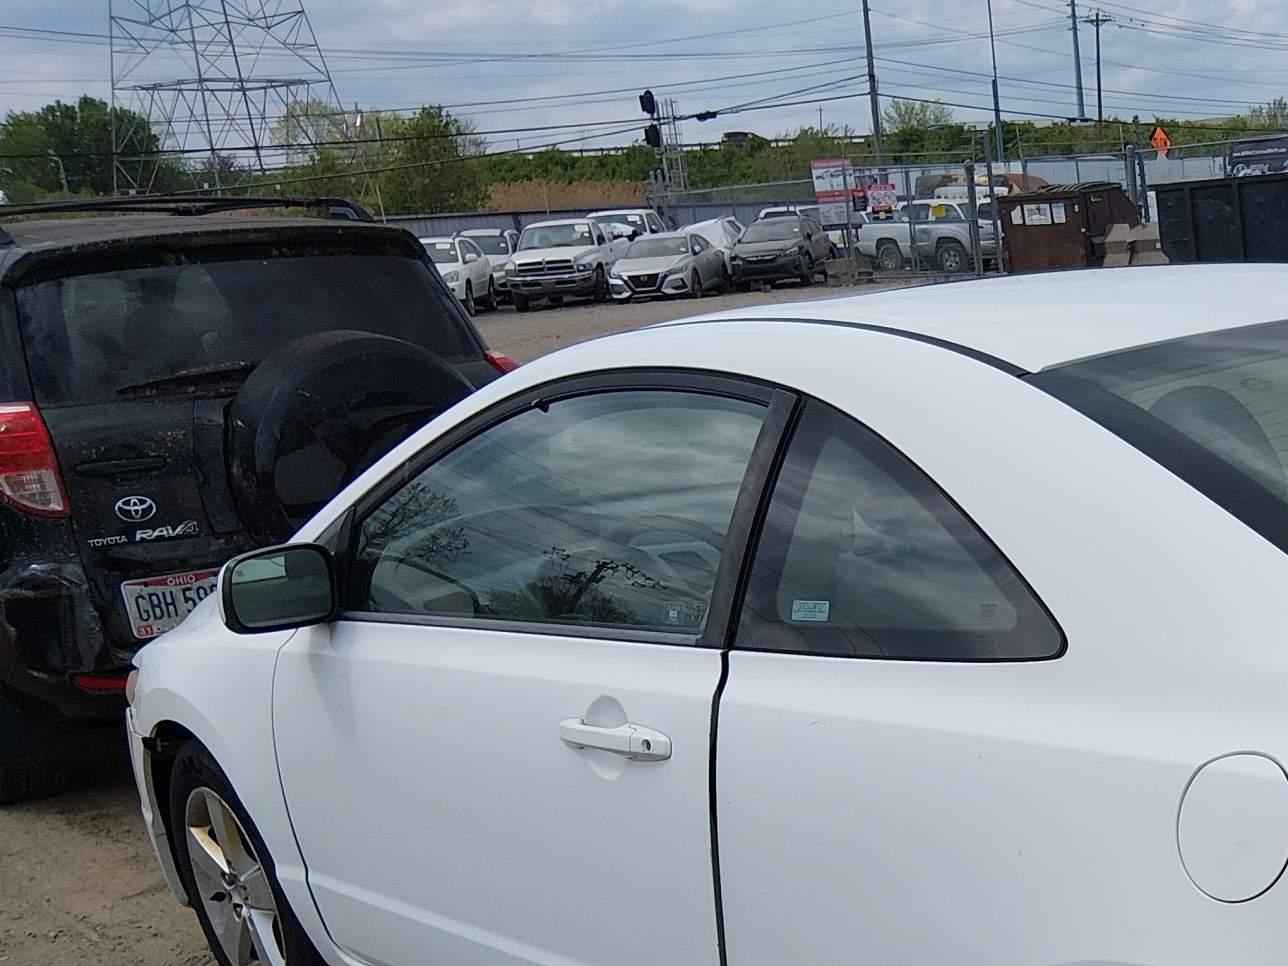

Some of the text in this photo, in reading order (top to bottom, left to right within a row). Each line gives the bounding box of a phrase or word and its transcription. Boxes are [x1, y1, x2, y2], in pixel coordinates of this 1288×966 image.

[87, 520, 200, 548] TOYOTA RAV4
[167, 574, 196, 586] OHIO
[135, 590, 179, 622] GBH
